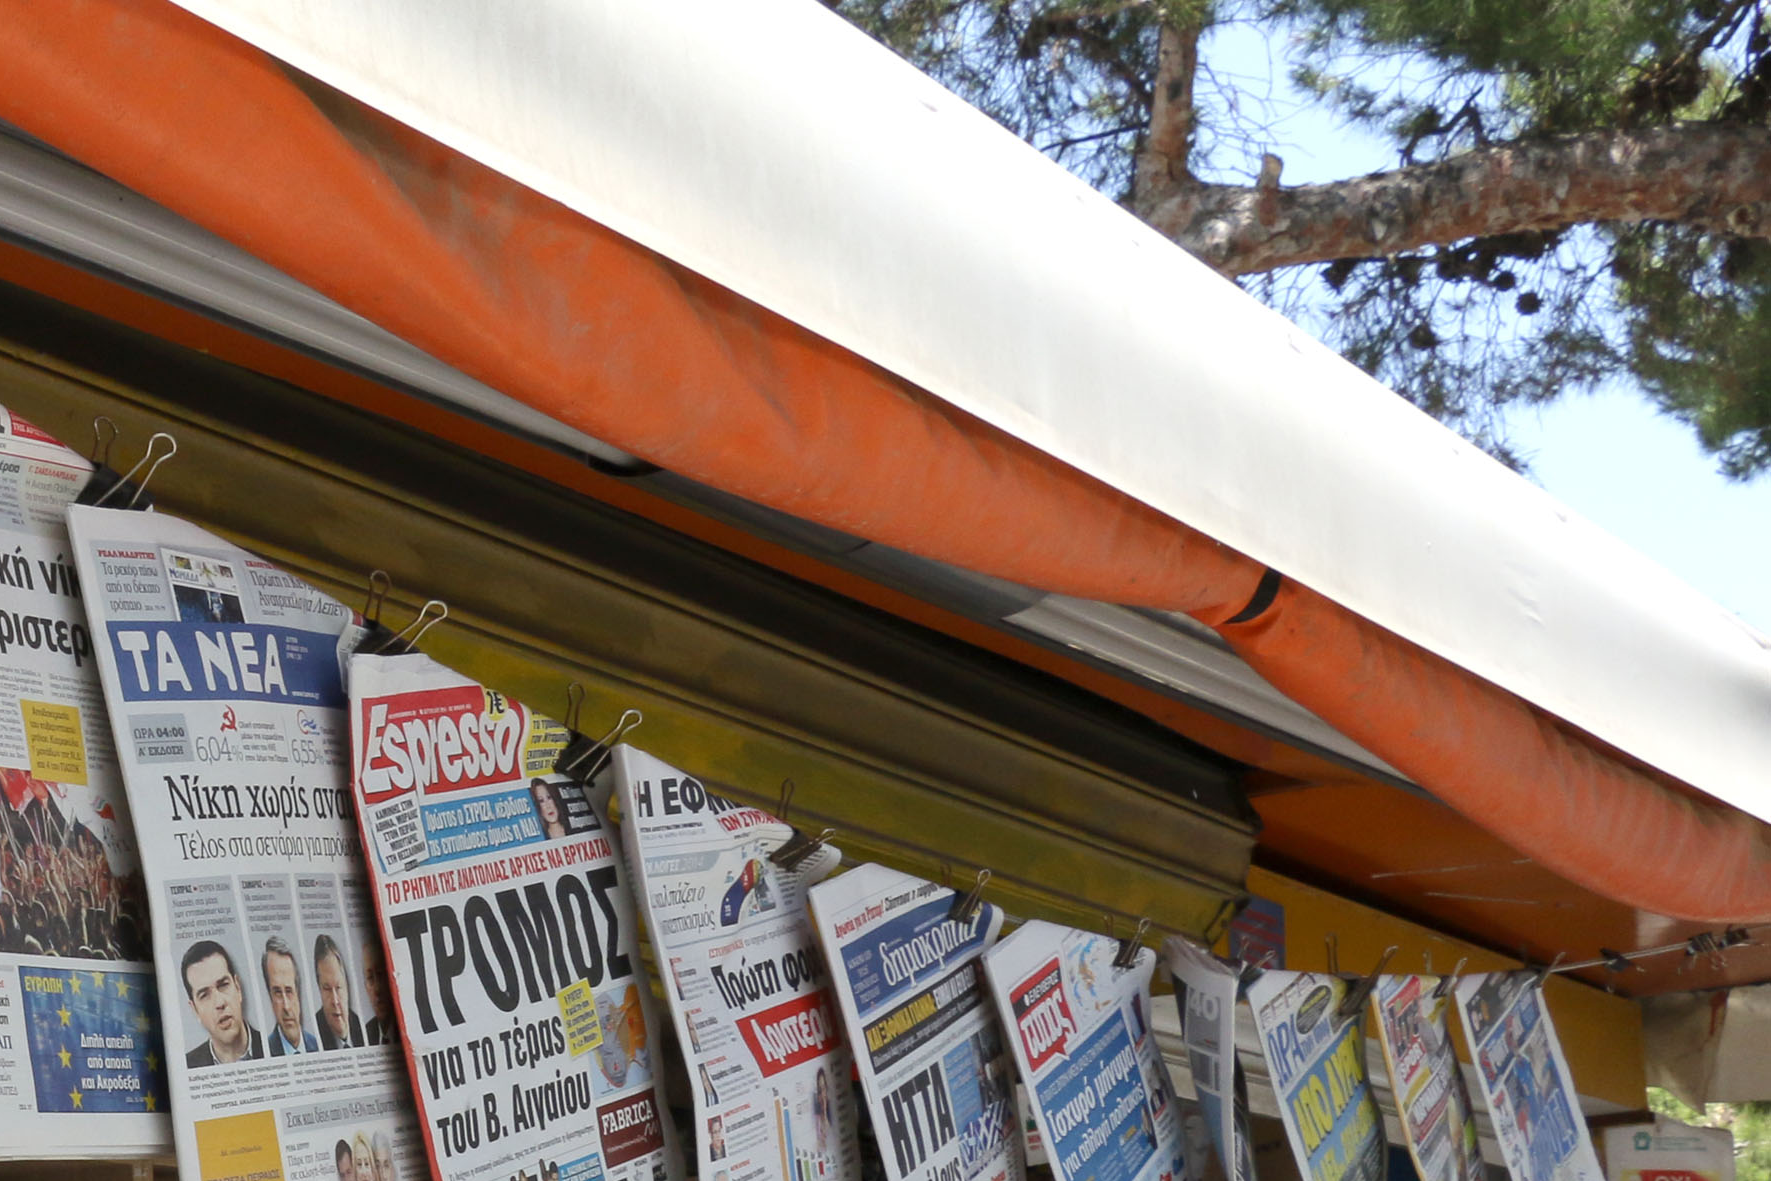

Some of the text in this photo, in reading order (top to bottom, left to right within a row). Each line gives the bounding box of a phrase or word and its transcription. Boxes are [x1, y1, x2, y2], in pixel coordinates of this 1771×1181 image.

[117, 630, 288, 695] ΤΑ ΝΕΑ
[134, 727, 185, 740] ΩΡΑ 04:00
[149, 746, 184, 756] ΕΚΔΟΣΗ
[360, 703, 523, 795] Espresso
[163, 775, 309, 829] Νίκη χωρίς
[174, 830, 304, 862] Τέλος στα σενάρια
[385, 882, 402, 905] ΤΟ
[403, 876, 439, 901] ΡΗΓΜΑ
[439, 871, 457, 895] ΤΗΣ
[457, 859, 510, 892] ΑΝΑΤΟΛΙΑΣ
[511, 851, 547, 878] ΑΡΧΙΣΕ
[548, 848, 563, 869] ΝΑ
[564, 838, 612, 864] ΒΡΥΧΑΤΑΙ
[389, 865, 634, 1035] ΤΡΟΜΟΣ
[24, 975, 64, 994] ΕΥΡΩΠΗ
[711, 955, 781, 1011] Πρώτη
[423, 1046, 466, 1100] για
[467, 1036, 497, 1080] το
[499, 1015, 566, 1071] τέρας
[436, 1106, 479, 1158] του
[483, 1092, 509, 1144] Β.
[512, 1069, 592, 1131] Αιγαίου
[601, 1100, 654, 1136] FABRICA
[882, 1060, 957, 1181] ΗΤΤΑ
[1047, 1073, 1097, 1144] Ισχυρό
